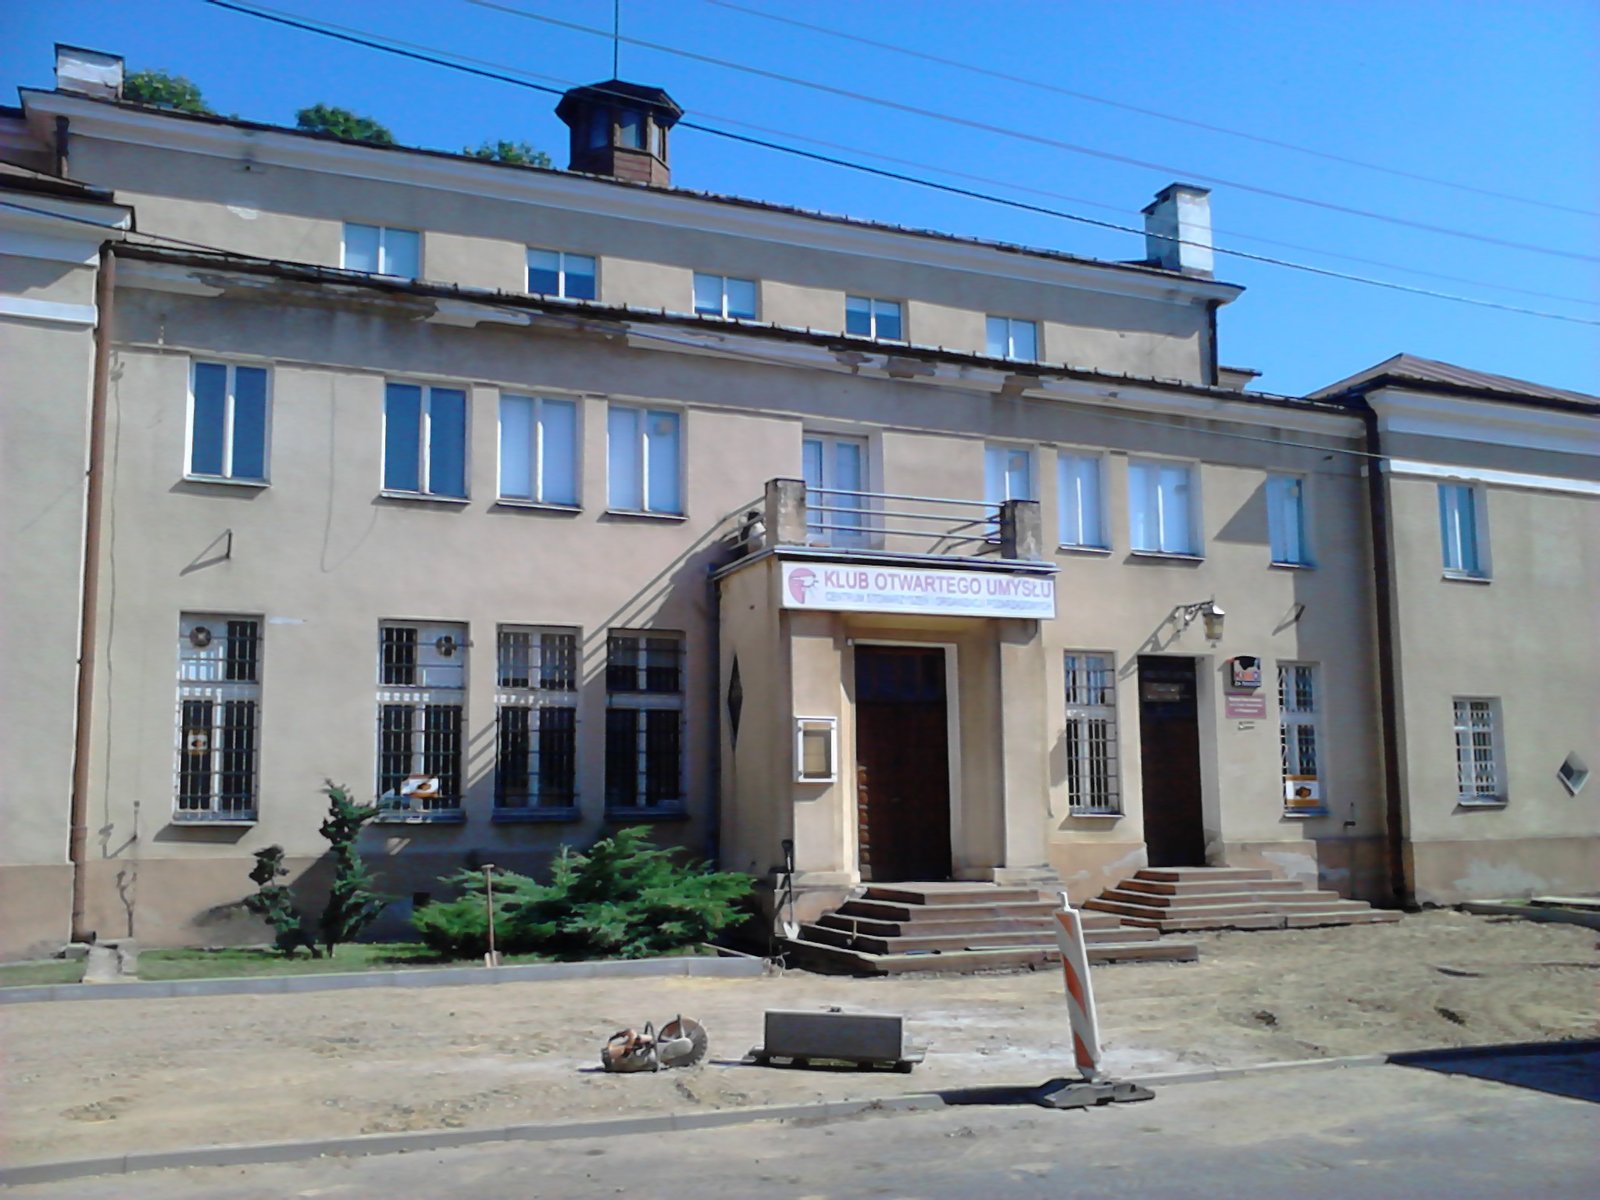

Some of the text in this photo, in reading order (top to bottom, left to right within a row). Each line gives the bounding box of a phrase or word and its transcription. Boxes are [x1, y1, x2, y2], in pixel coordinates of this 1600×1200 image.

[824, 570, 1052, 598] KLUB OTWARTEGO UMYSŁU
